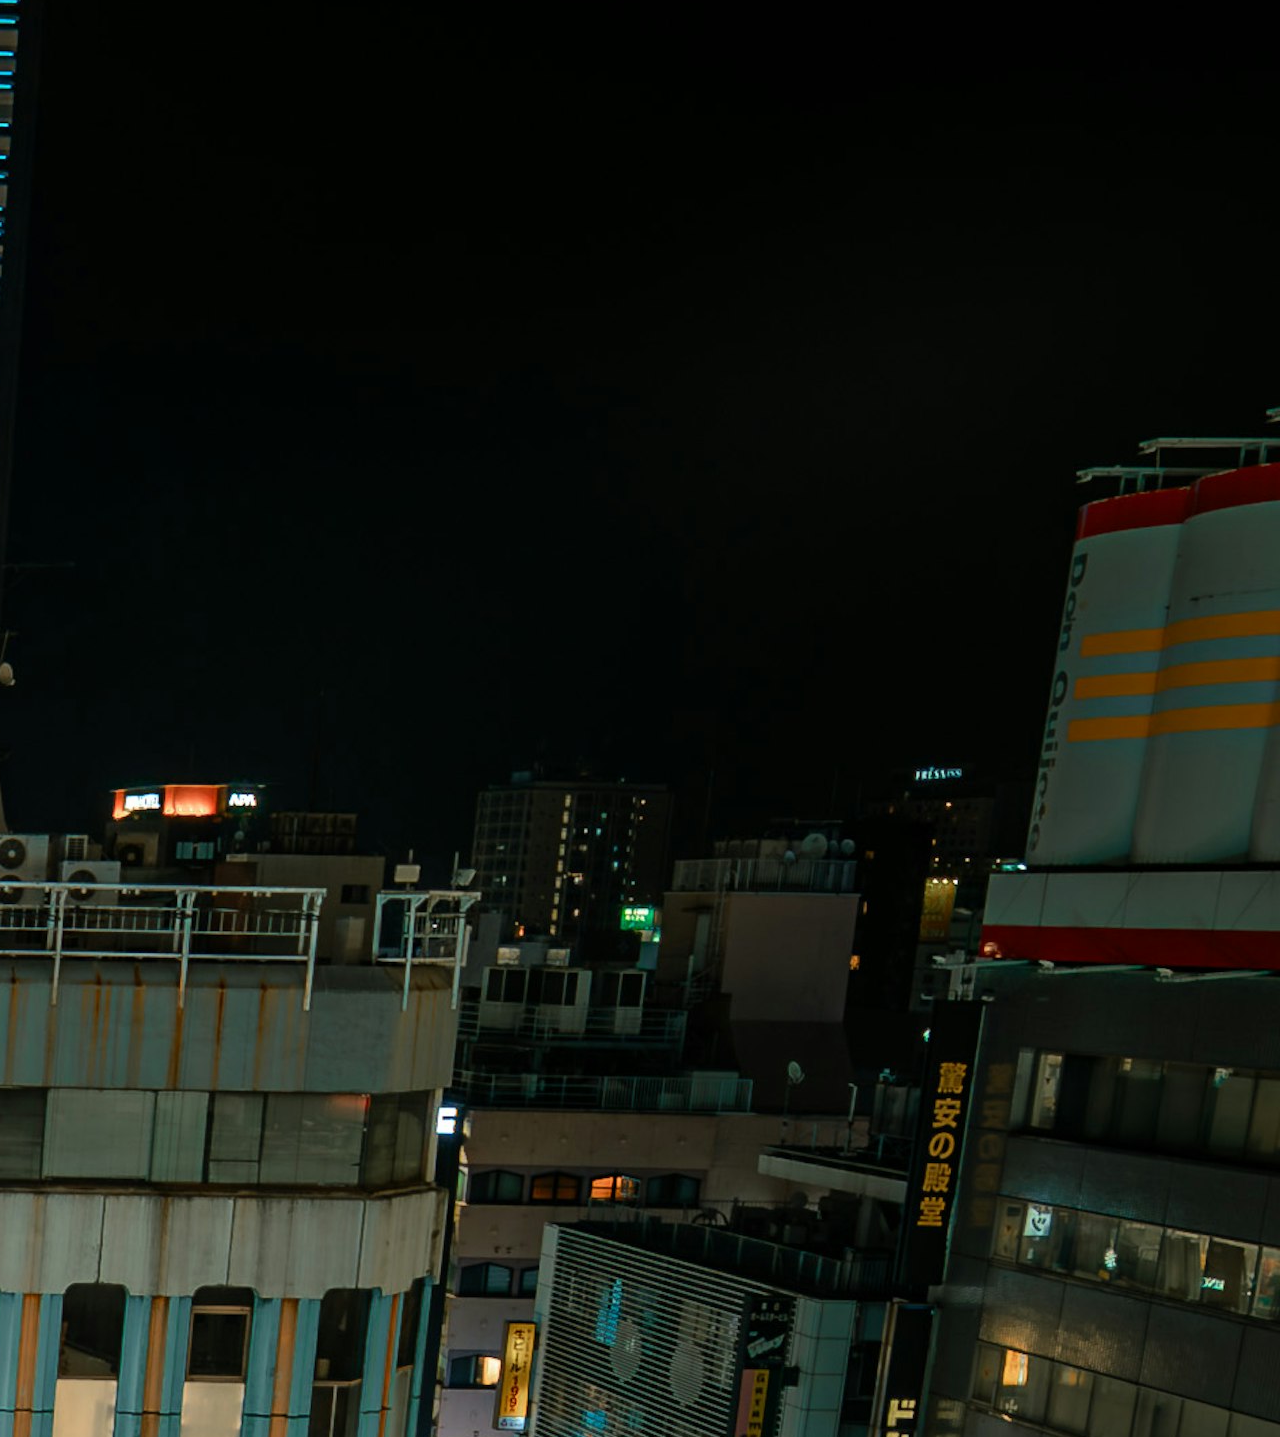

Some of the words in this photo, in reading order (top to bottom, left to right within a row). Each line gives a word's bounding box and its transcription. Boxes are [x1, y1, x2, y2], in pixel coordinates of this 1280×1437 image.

[917, 1062, 967, 1226] 驚安の殿堂
